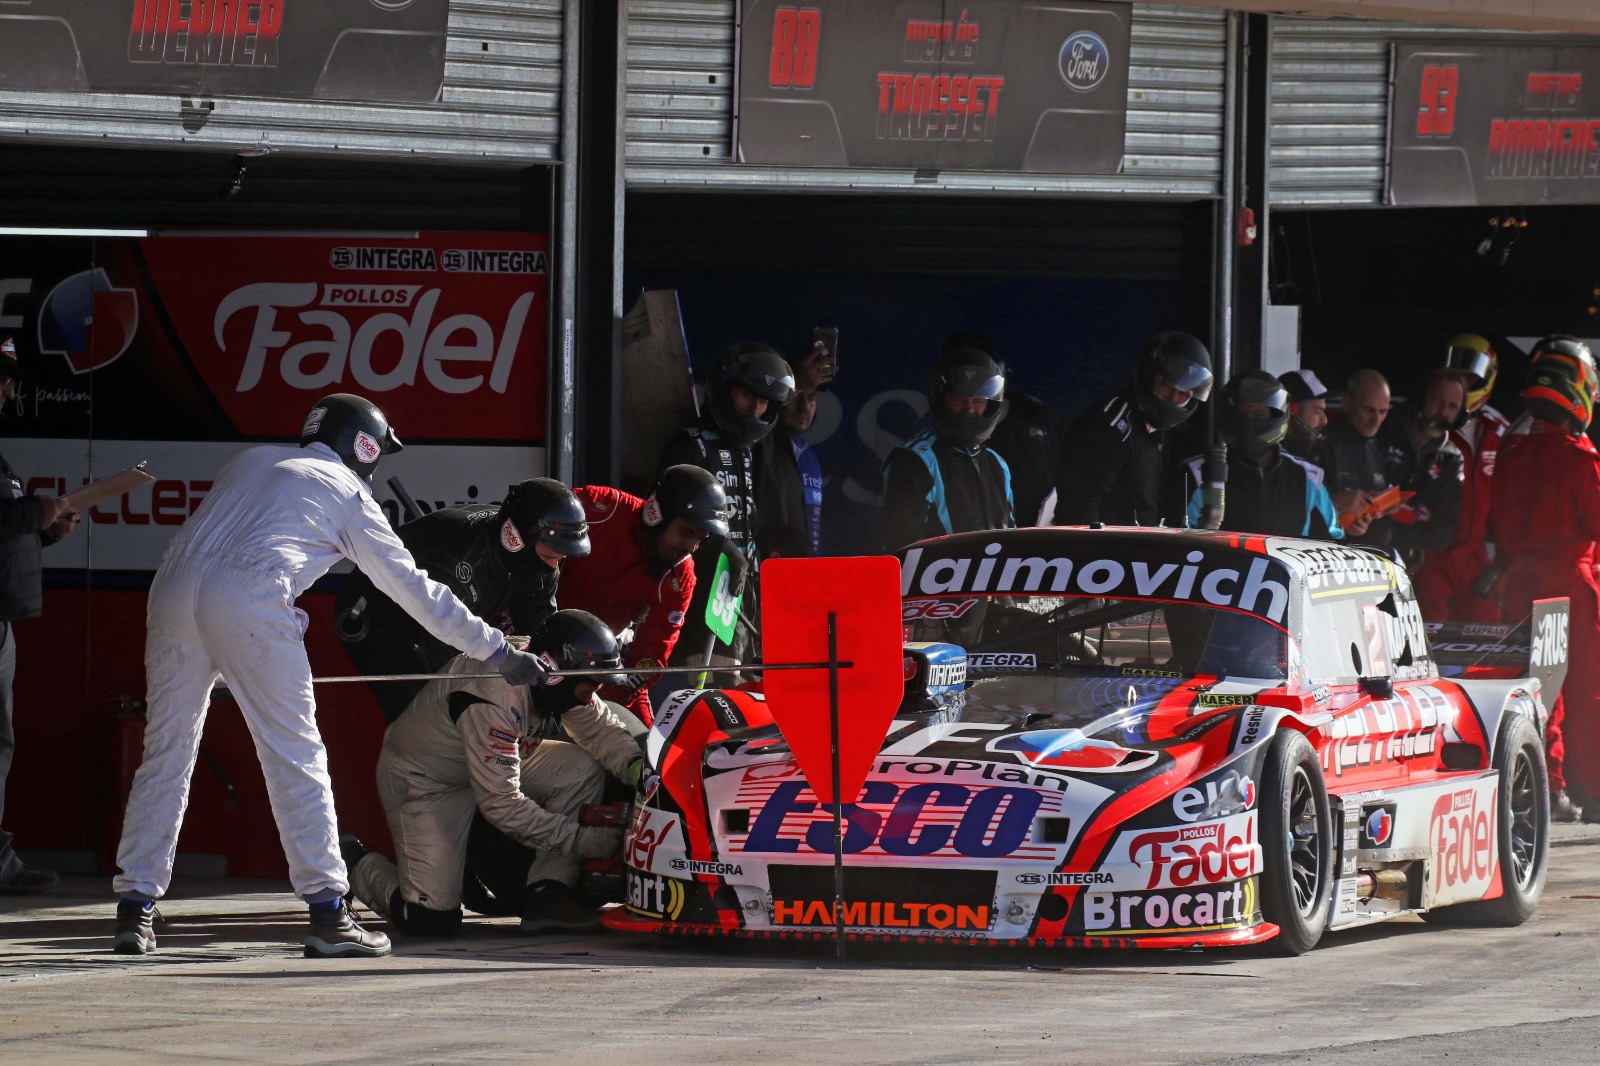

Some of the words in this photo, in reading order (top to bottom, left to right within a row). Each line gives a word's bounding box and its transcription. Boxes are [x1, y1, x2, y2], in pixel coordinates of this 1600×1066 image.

[769, 7, 822, 89] 88
[1067, 40, 1100, 80] Ford
[1416, 64, 1459, 138] 93
[356, 248, 436, 270] INTEGRA
[467, 251, 548, 273] INTEGRA
[330, 288, 408, 304] POLLOS
[214, 282, 535, 394] Fadel
[902, 600, 978, 620] del
[1199, 694, 1254, 706] KAESER
[866, 759, 1069, 792] roPlan
[1454, 792, 1472, 809] POLLOS
[742, 780, 1045, 857] ESCO
[1183, 827, 1216, 840] POLLOS
[1129, 816, 1257, 890] Fadel
[1429, 788, 1497, 895] Fadel
[689, 860, 744, 876] INTEGRA
[1047, 872, 1114, 885] INTEGRA
[774, 900, 988, 930] HAMILTON
[1084, 881, 1243, 930] Brocart
